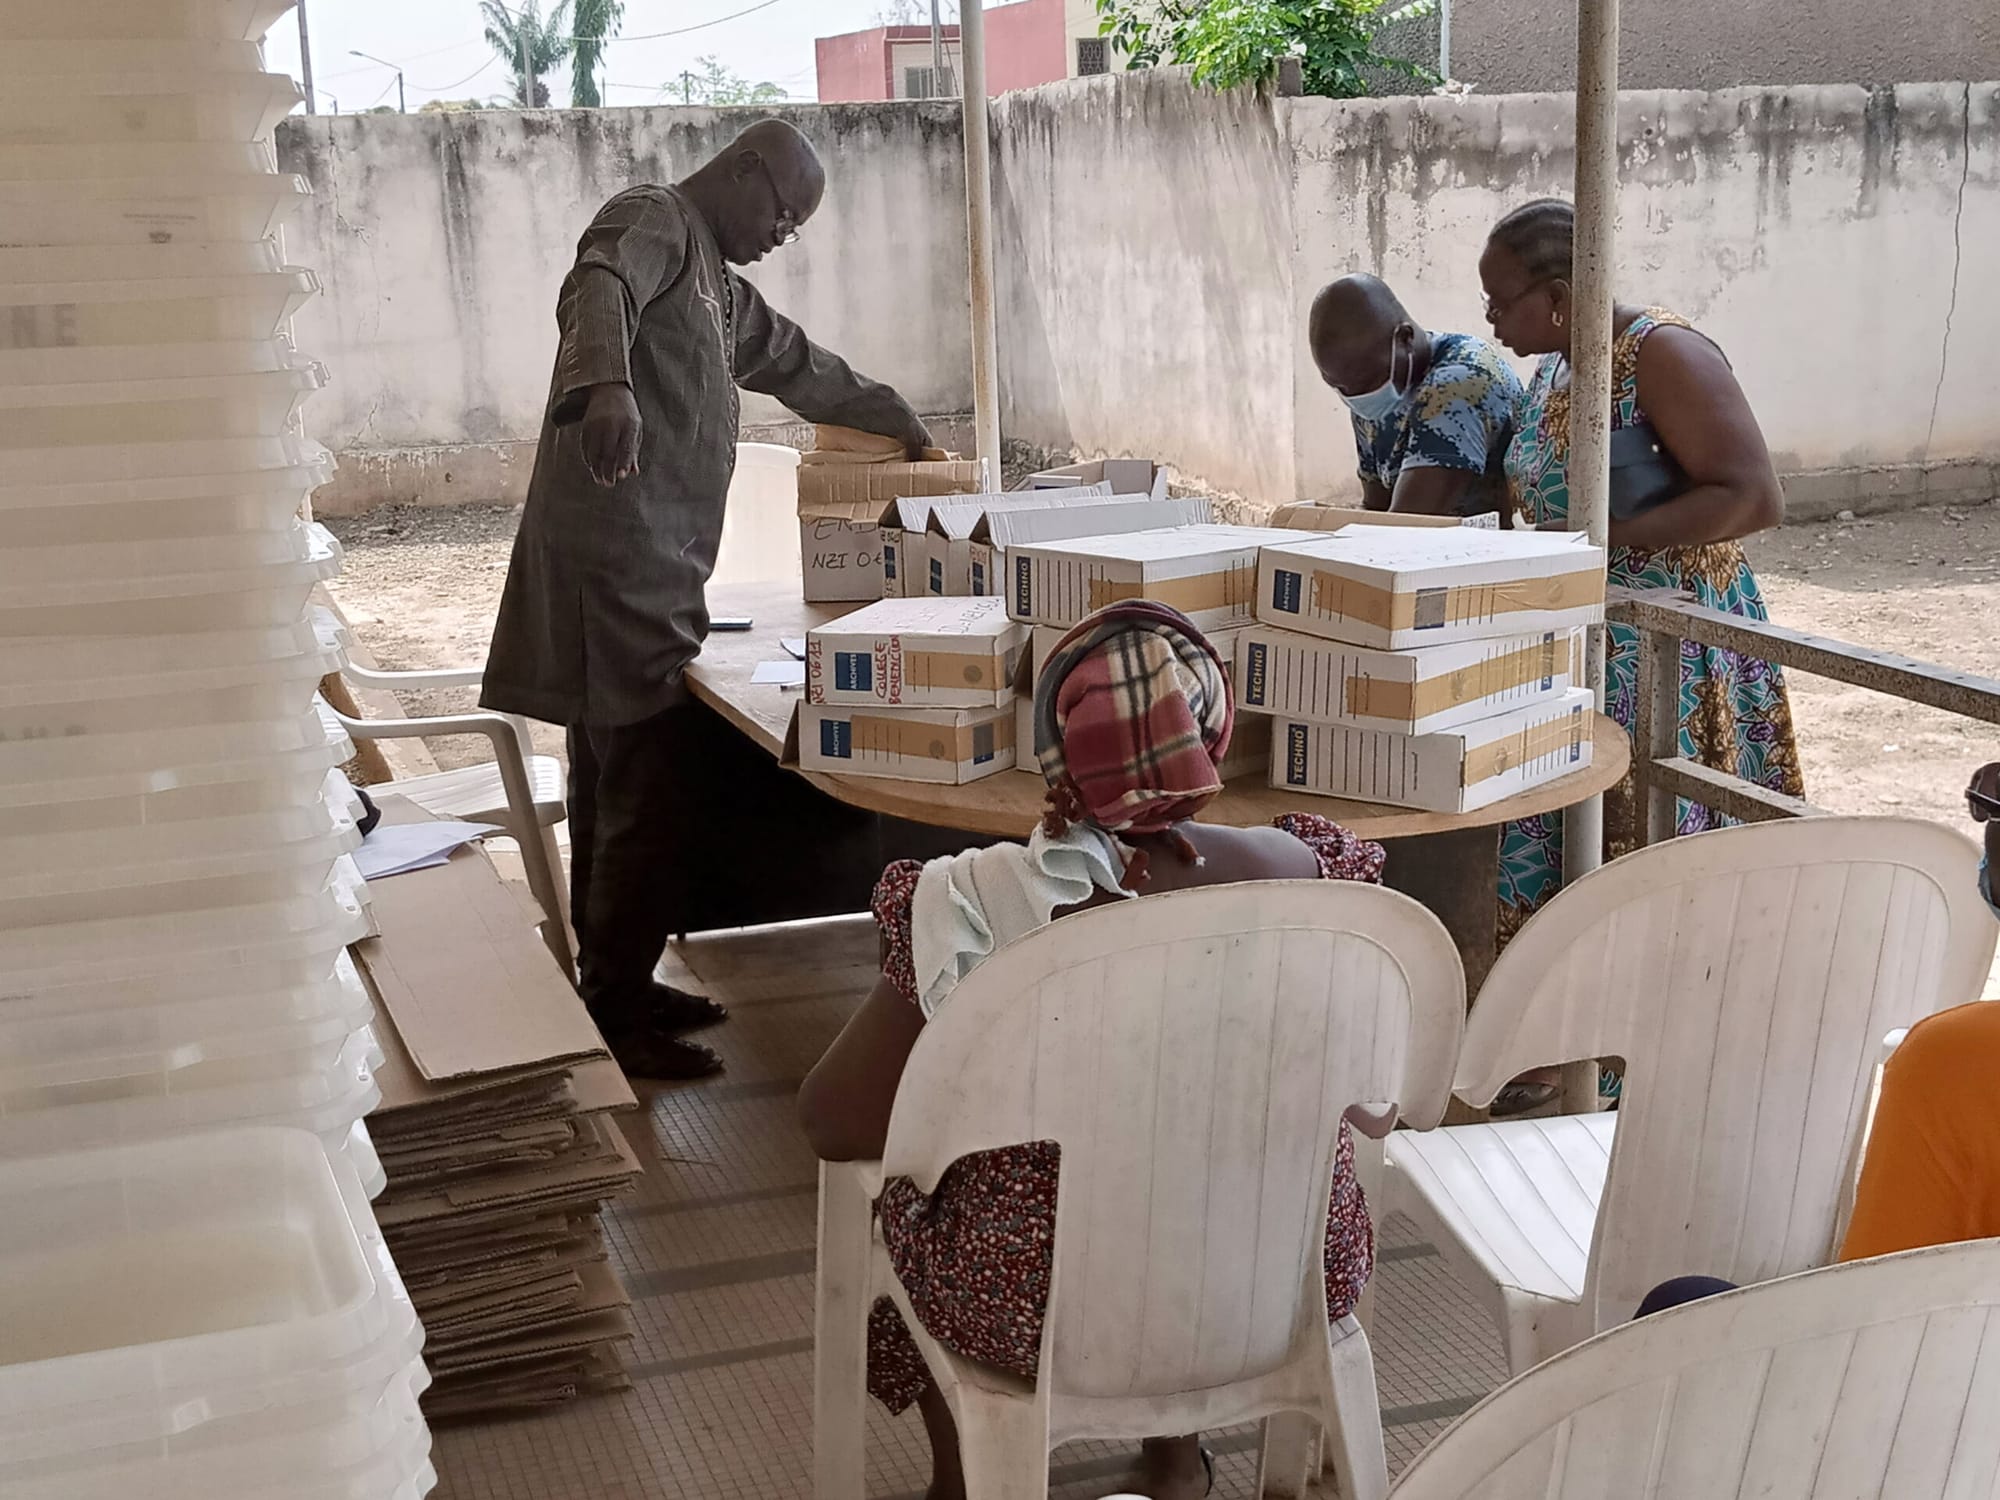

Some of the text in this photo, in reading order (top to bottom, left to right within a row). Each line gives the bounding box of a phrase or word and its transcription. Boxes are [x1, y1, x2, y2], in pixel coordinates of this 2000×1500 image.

[1020, 561, 1029, 611] TECHNO
[1252, 649, 1263, 700] TECHNO
[1293, 728, 1305, 781] TECHNO
